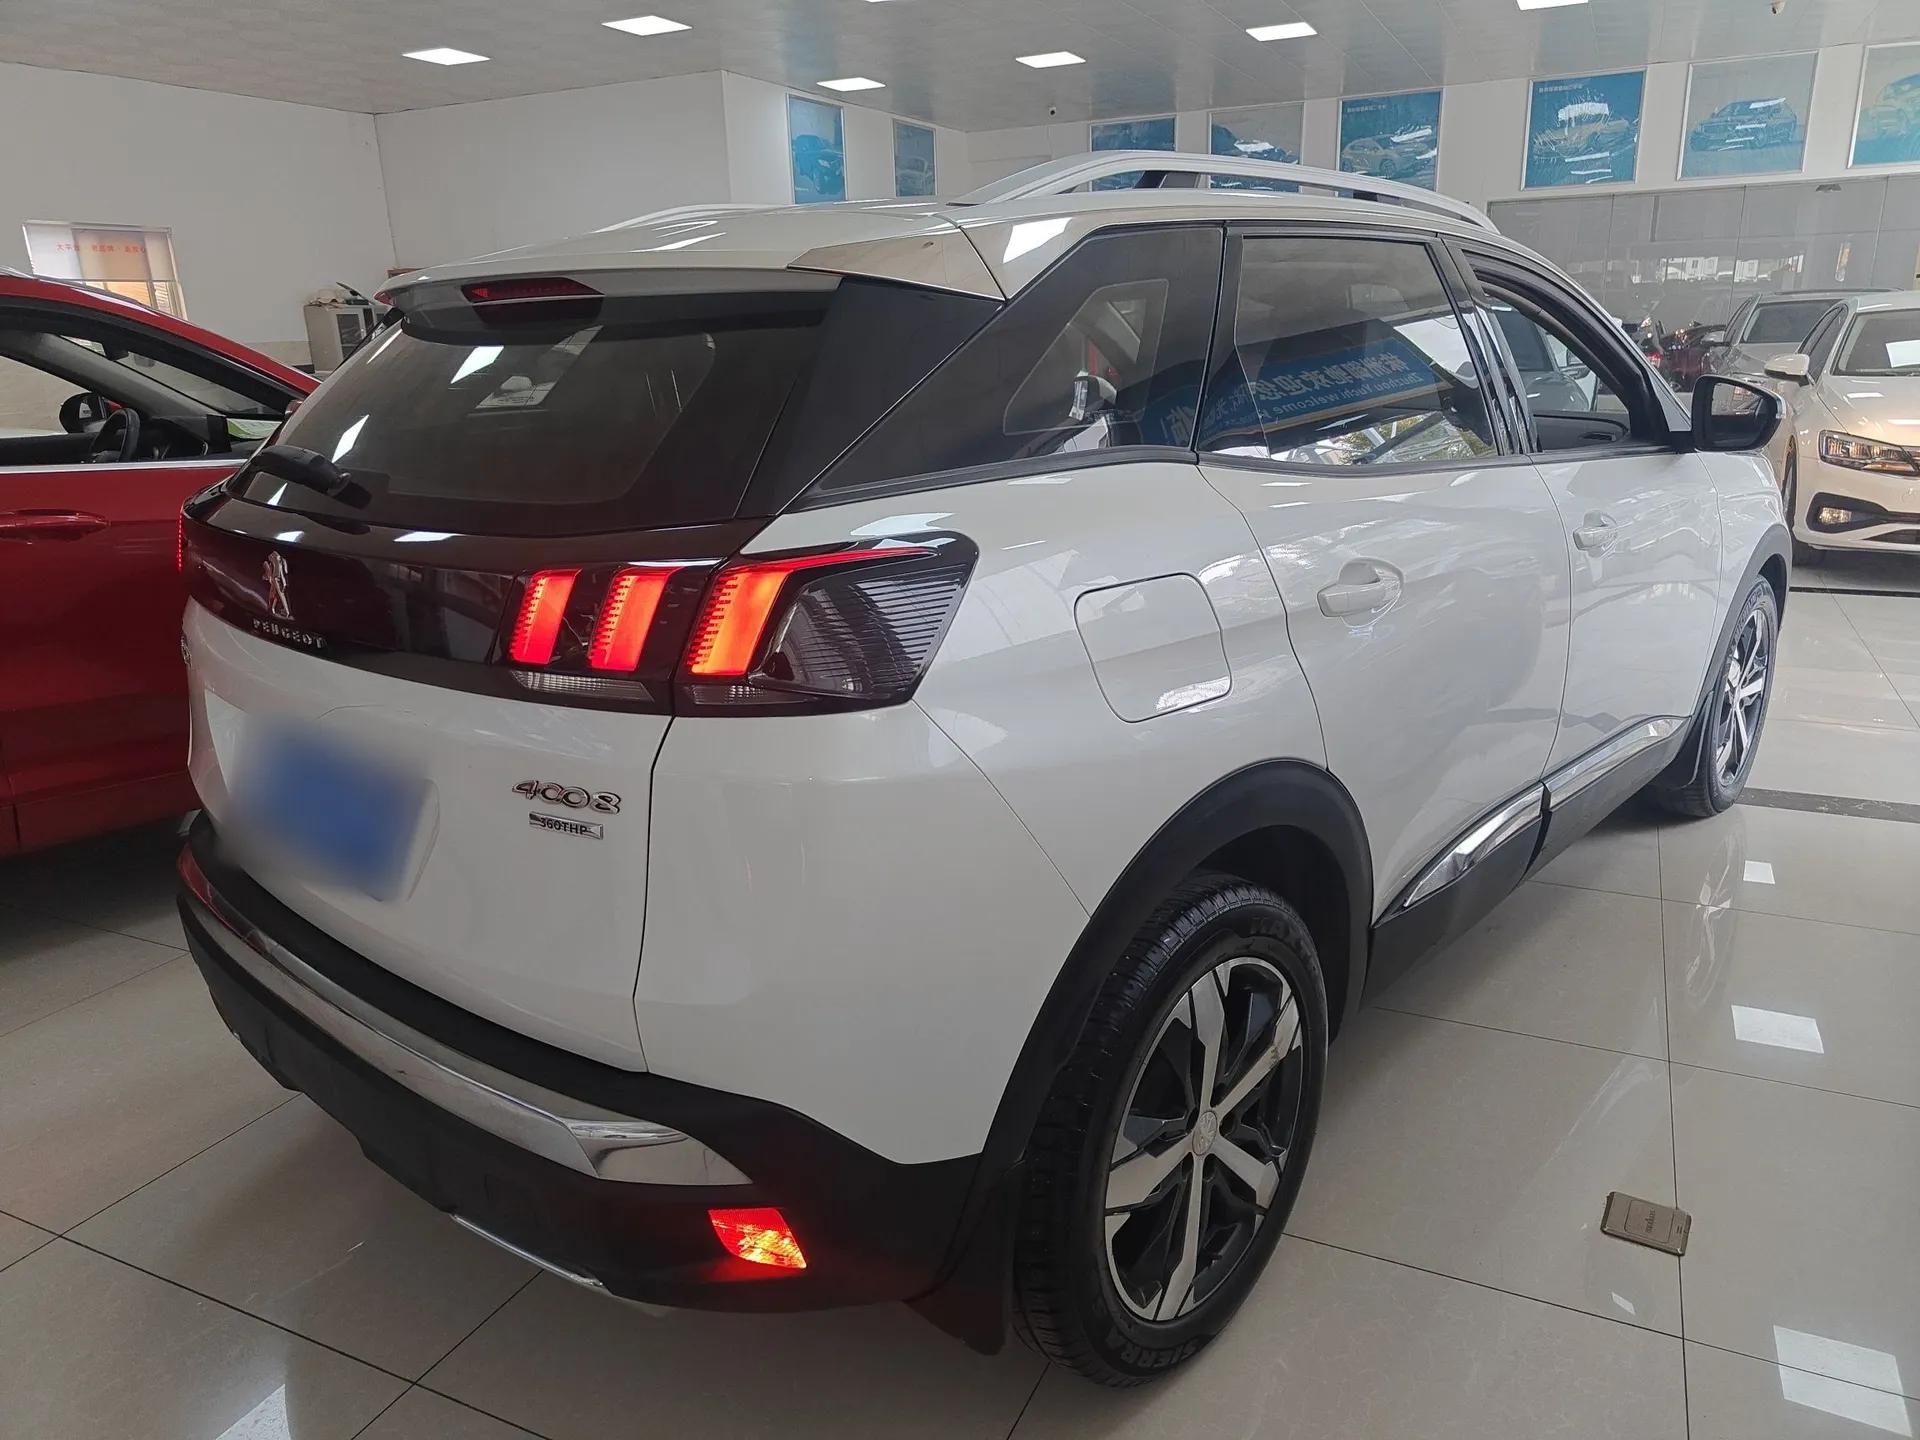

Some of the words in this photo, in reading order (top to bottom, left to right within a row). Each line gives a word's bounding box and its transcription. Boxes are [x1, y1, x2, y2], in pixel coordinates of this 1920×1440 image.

[253, 618, 327, 649] PEUGEOT
[511, 780, 621, 814] 4008
[539, 817, 588, 834] 360THP
[1105, 1328, 1201, 1368] SIERRA
